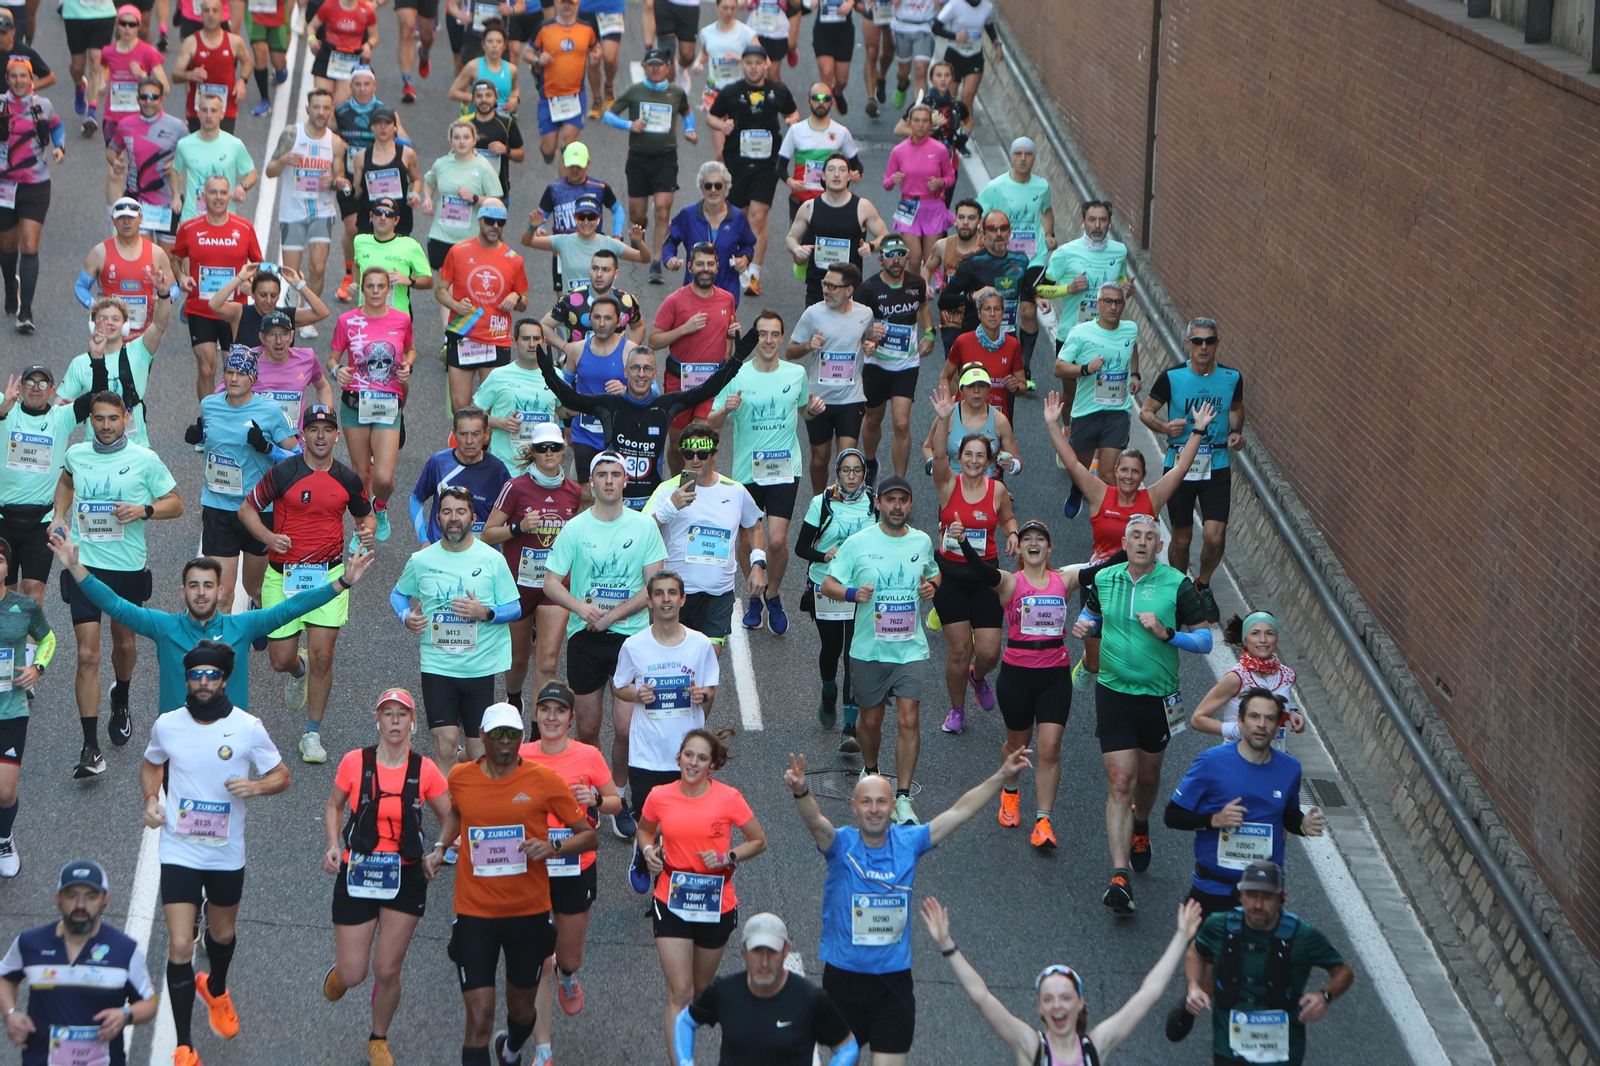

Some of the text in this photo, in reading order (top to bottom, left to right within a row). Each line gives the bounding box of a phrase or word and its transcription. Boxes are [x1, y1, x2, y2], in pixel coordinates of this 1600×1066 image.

[198, 238, 238, 247] CANADA
[210, 268, 231, 276] ZURICH
[490, 315, 508, 325] RUN
[831, 353, 852, 361] ZURICH
[831, 364, 844, 372] 7723
[276, 392, 298, 400] ZURICH
[373, 391, 393, 399] ZURICH
[526, 413, 548, 421] ZURICH
[25, 434, 50, 444] ZURICH
[617, 433, 656, 450] George
[767, 451, 788, 459] ZURICH
[217, 456, 237, 466] ZURICH
[702, 528, 726, 537] ZURICH
[600, 591, 626, 599] ZURICH
[1037, 598, 1061, 606] ZURICH
[889, 603, 912, 611] ZURICH
[445, 613, 471, 622] ZURICH
[1037, 611, 1052, 619] 8402
[659, 677, 686, 686] ZURICH
[658, 692, 677, 700] 12968
[196, 803, 226, 813] ZURICH
[488, 829, 517, 838] ZURICH
[1239, 826, 1267, 835] ZURICH
[548, 831, 574, 839] ZURICH
[366, 855, 394, 864] ZURICH
[689, 878, 717, 886] ZURICH
[872, 898, 901, 906] ZURICH
[682, 902, 707, 911] CAMILLE
[1250, 1012, 1281, 1022] ZURICH
